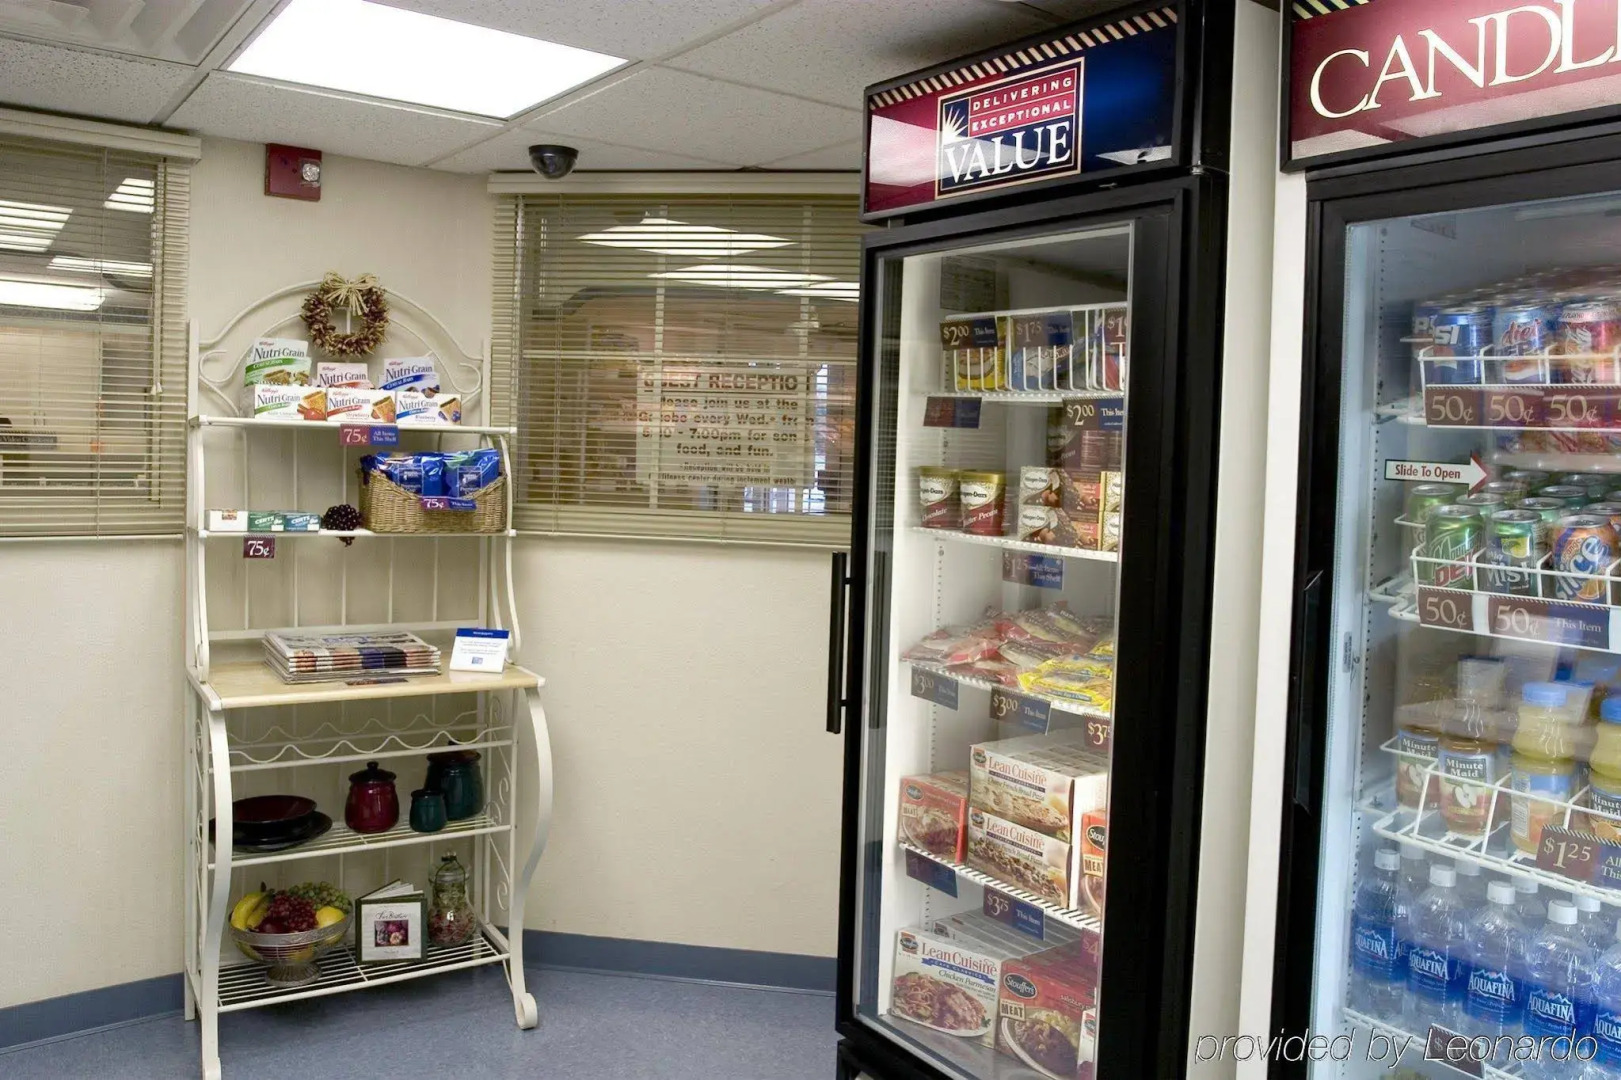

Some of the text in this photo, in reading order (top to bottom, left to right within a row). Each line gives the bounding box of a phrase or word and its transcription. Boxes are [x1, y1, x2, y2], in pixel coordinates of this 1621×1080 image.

[1310, 0, 1621, 118] CANDL
[973, 77, 1072, 110] DELIVERING
[972, 101, 1071, 131] EXCEPTIONAL
[944, 121, 1071, 183] VALUE
[1431, 395, 1474, 424] 50¢
[1488, 395, 1536, 424] 50¢
[1550, 395, 1598, 424] 50¢
[343, 428, 368, 443] 75¢
[677, 442, 710, 456] food,
[716, 445, 741, 456] and
[1395, 464, 1461, 480] Slide To Open
[255, 516, 275, 525] CERTS
[291, 516, 310, 525] CERTS
[247, 540, 270, 556] 75¢
[1426, 596, 1467, 627] 50¢
[1496, 604, 1602, 636] 50¢ This Item
[1402, 738, 1437, 751] Minute
[988, 756, 1011, 775] Lean
[1012, 764, 1047, 786] Cuisine
[1446, 758, 1484, 770] Minute
[1450, 768, 1480, 778] Maid
[987, 817, 1009, 836] Lean
[1010, 827, 1045, 850] Cuisine
[922, 942, 951, 962] Lean
[952, 952, 997, 977] Cuisine
[939, 969, 996, 993] Chicken Parmesan
[1468, 973, 1515, 1001] AQUAFINA
[1001, 1003, 1024, 1018] MEAT
[1528, 993, 1576, 1024] AQUAFINA
